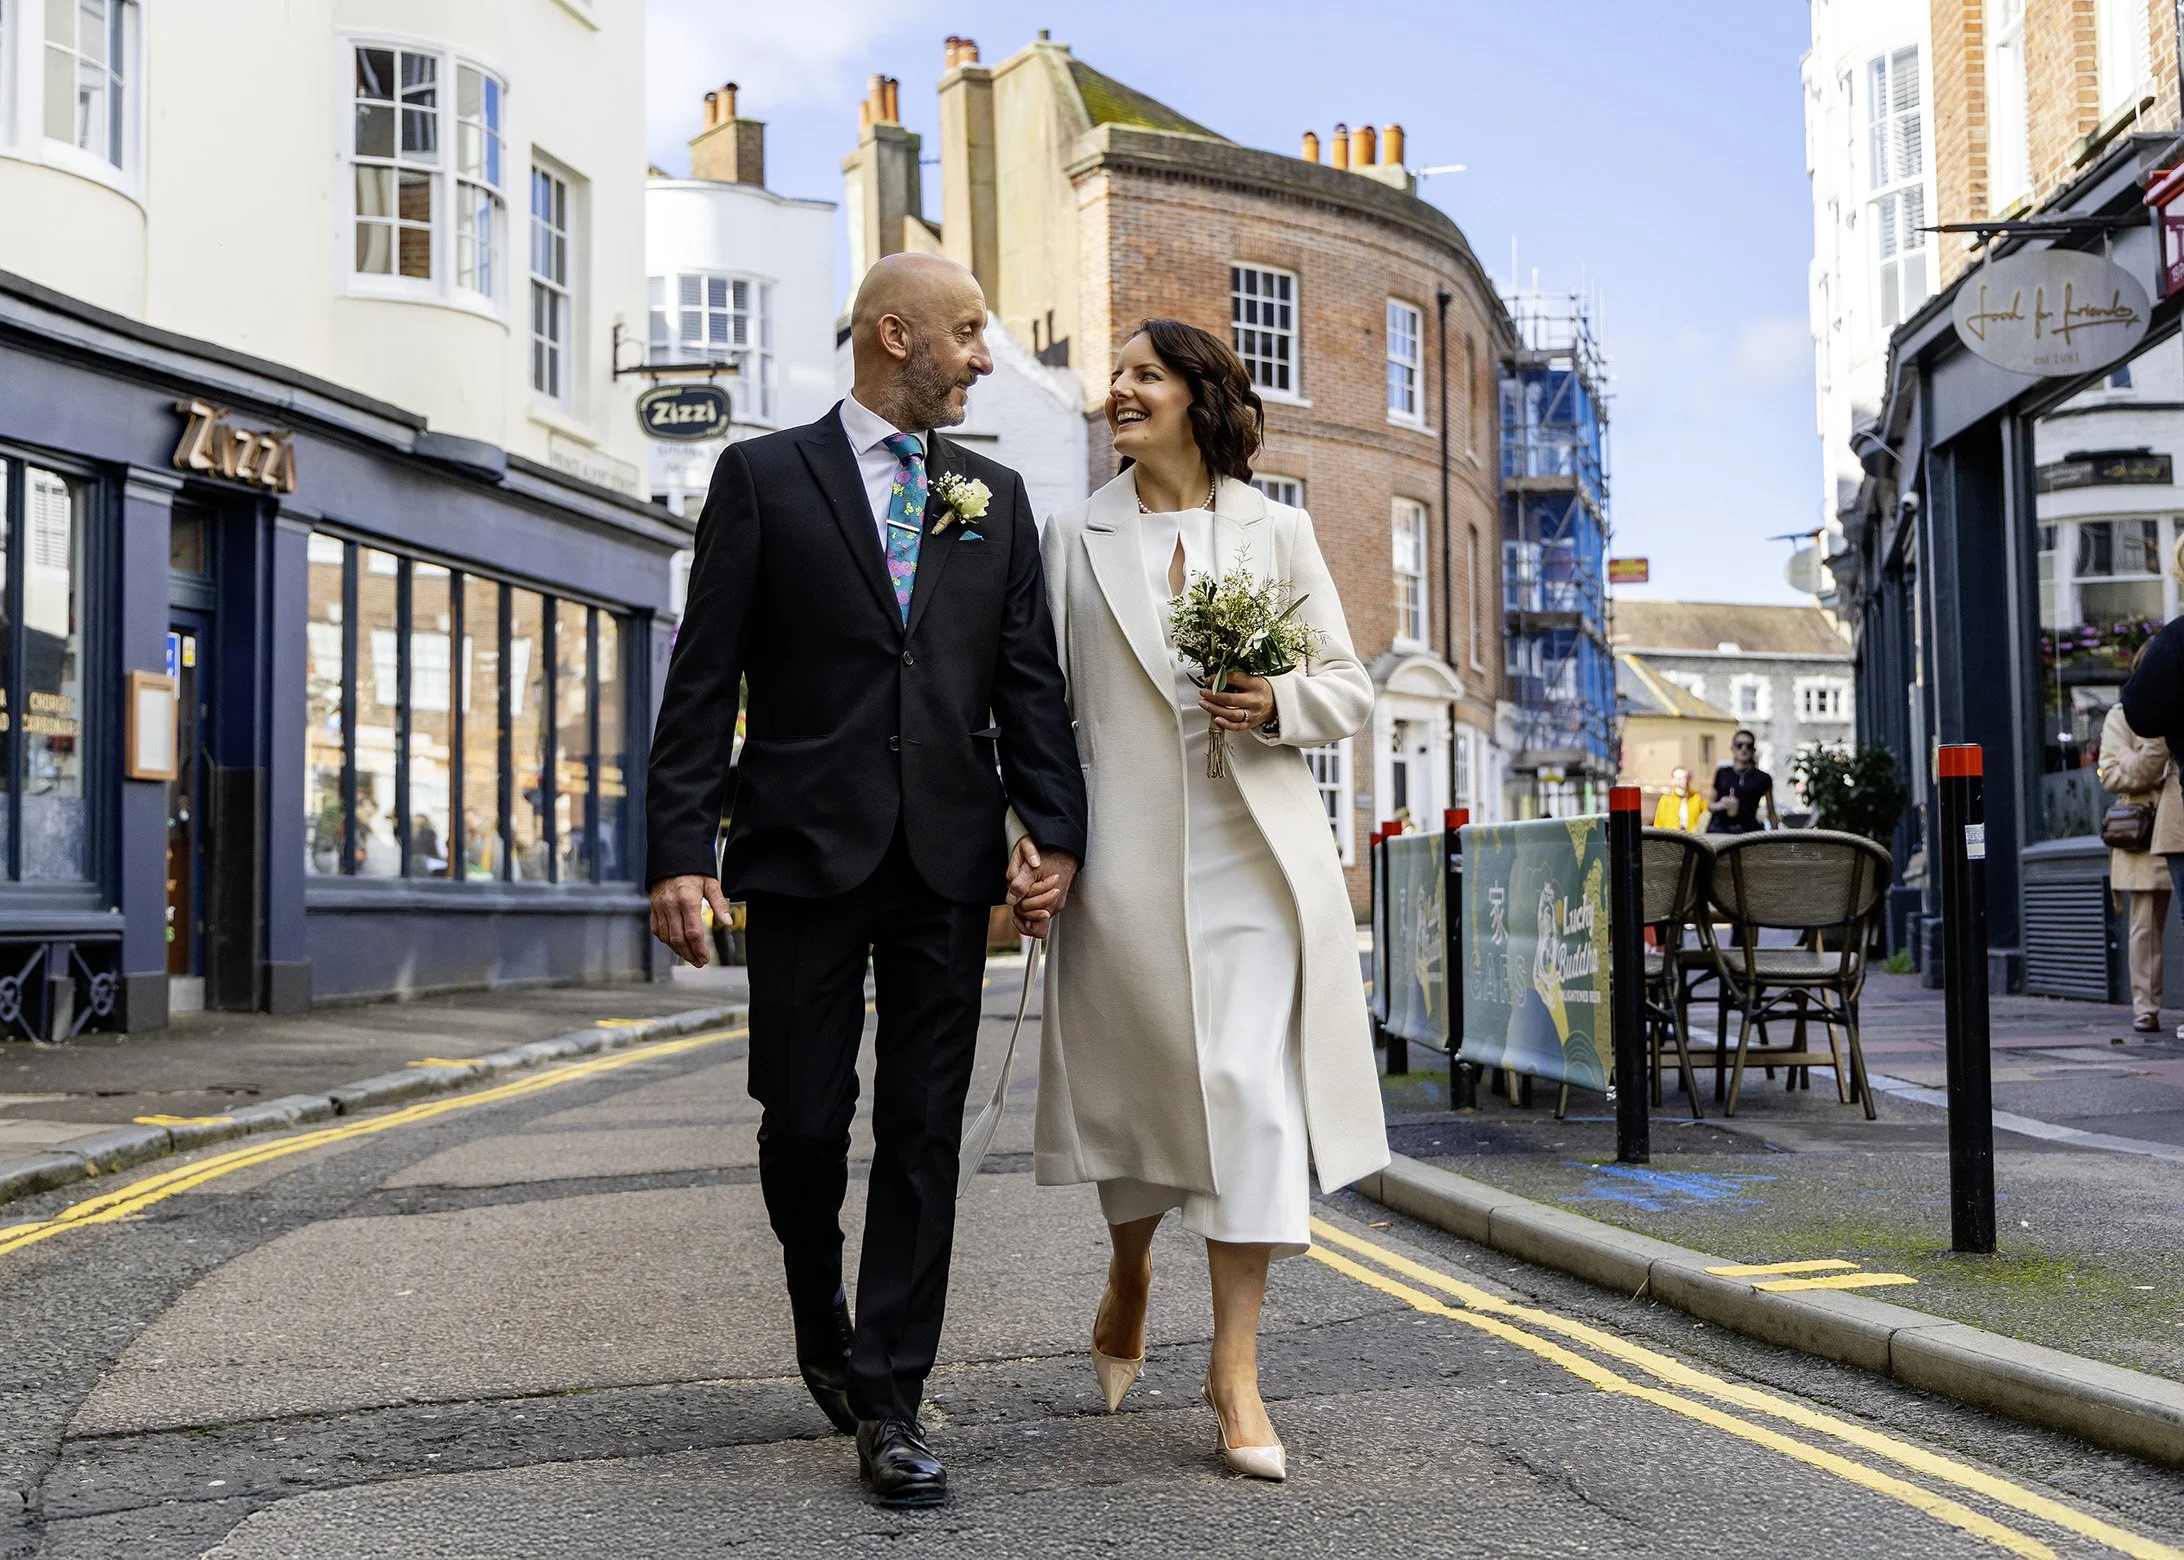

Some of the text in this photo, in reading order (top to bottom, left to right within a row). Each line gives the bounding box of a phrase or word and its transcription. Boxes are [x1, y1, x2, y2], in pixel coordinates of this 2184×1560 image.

[650, 399, 717, 426] Zizzi
[174, 398, 297, 494] Zizzi
[1562, 892, 1595, 938] Lucky
[1557, 942, 1600, 983] Buddha
